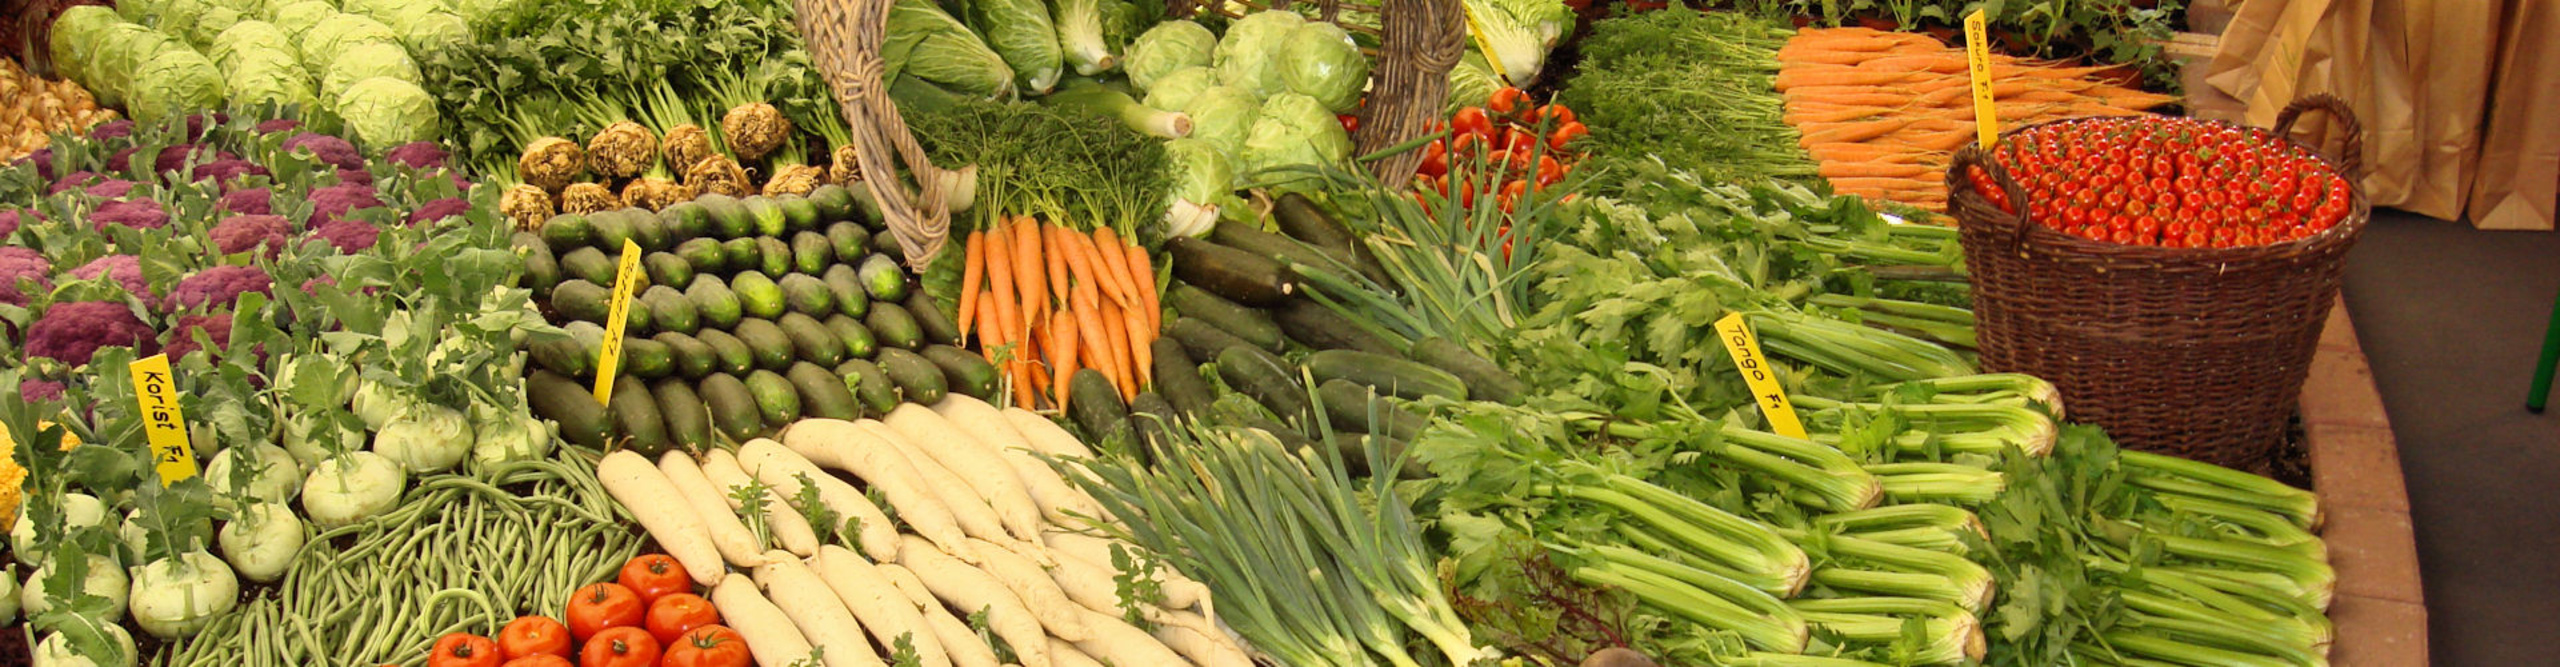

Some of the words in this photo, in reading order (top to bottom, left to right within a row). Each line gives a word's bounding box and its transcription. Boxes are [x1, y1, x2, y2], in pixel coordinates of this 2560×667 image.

[1728, 324, 1765, 381] Tango
[1765, 393, 1782, 409] F1
[143, 371, 179, 430] Korist
[162, 445, 184, 463] F1
